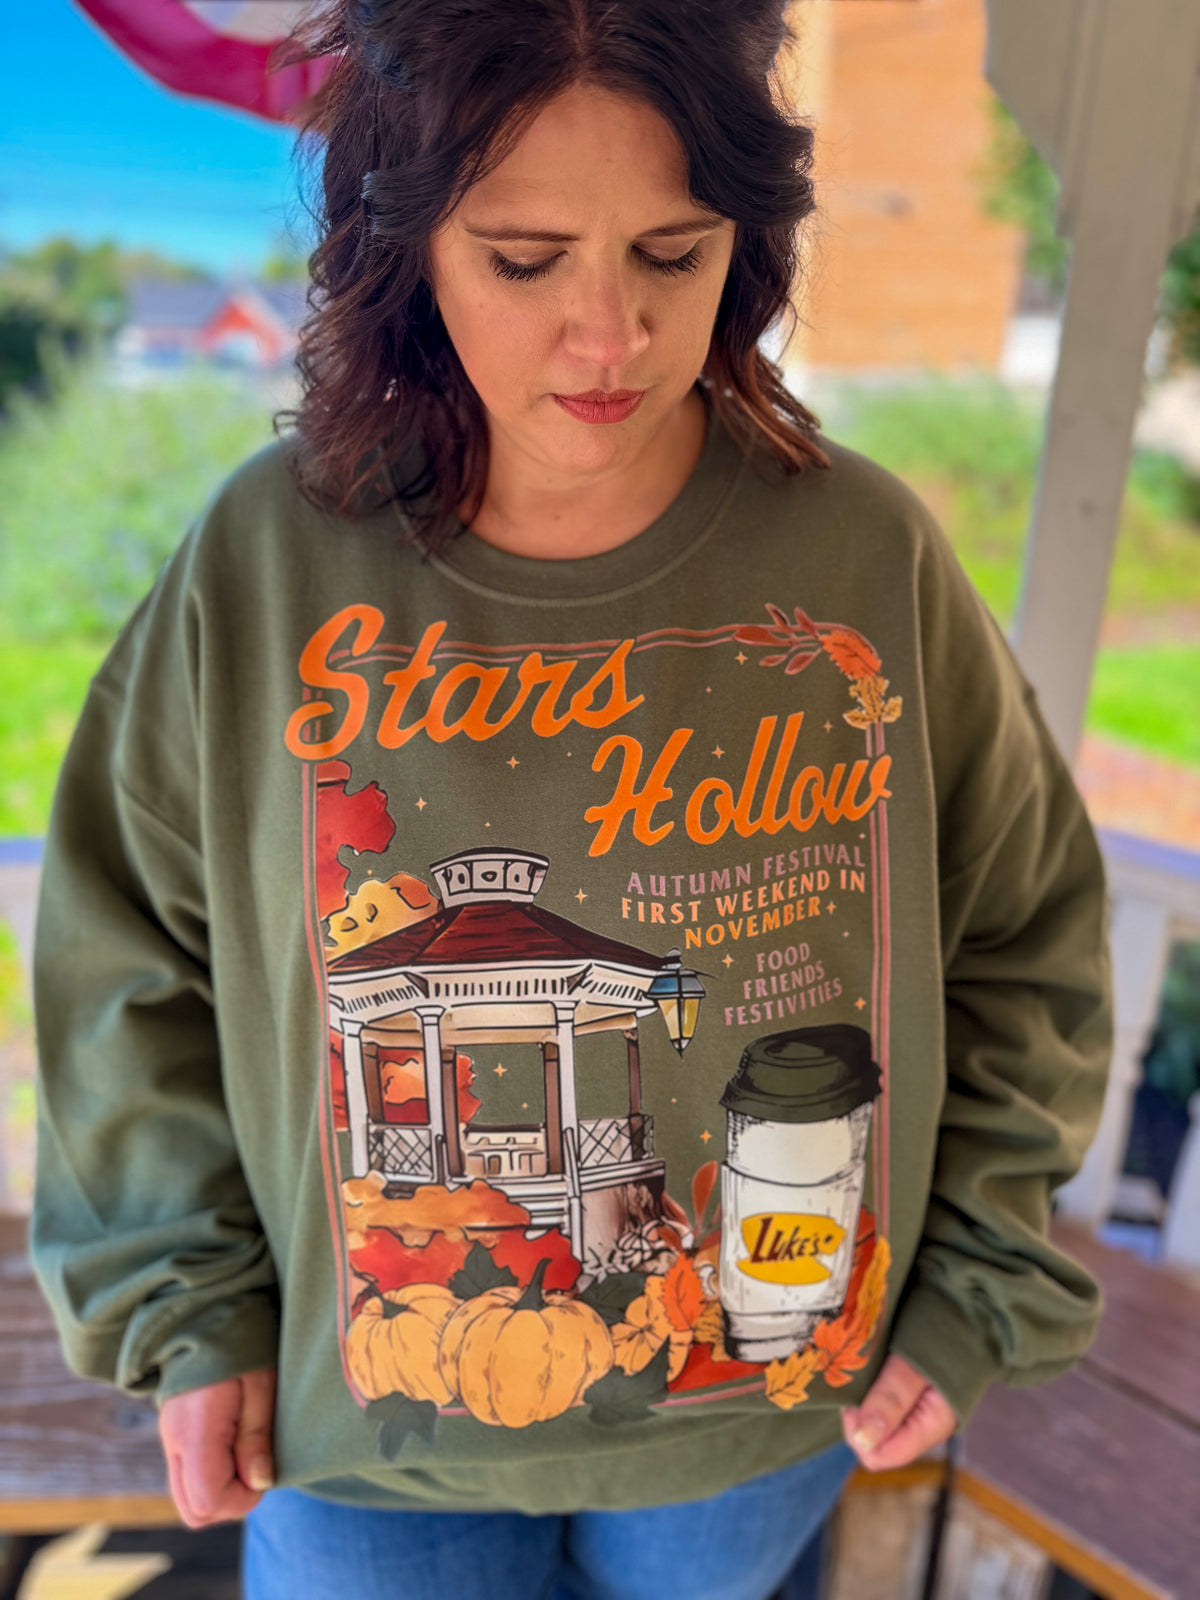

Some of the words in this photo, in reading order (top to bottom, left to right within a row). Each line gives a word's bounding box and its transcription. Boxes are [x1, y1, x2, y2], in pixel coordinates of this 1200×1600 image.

[284, 603, 645, 760] Stars
[584, 712, 892, 857] Hollow
[621, 897, 702, 924] FIRST
[715, 870, 830, 917] WEEKEND
[840, 869, 866, 893] IN
[627, 863, 751, 897] AUTUMN
[763, 844, 866, 880] FESTIVAL
[685, 896, 821, 949] NOVEMBER
[743, 960, 825, 999] FRIENDS
[756, 942, 811, 972] FOOD
[724, 978, 843, 1025] FESTIVITIES
